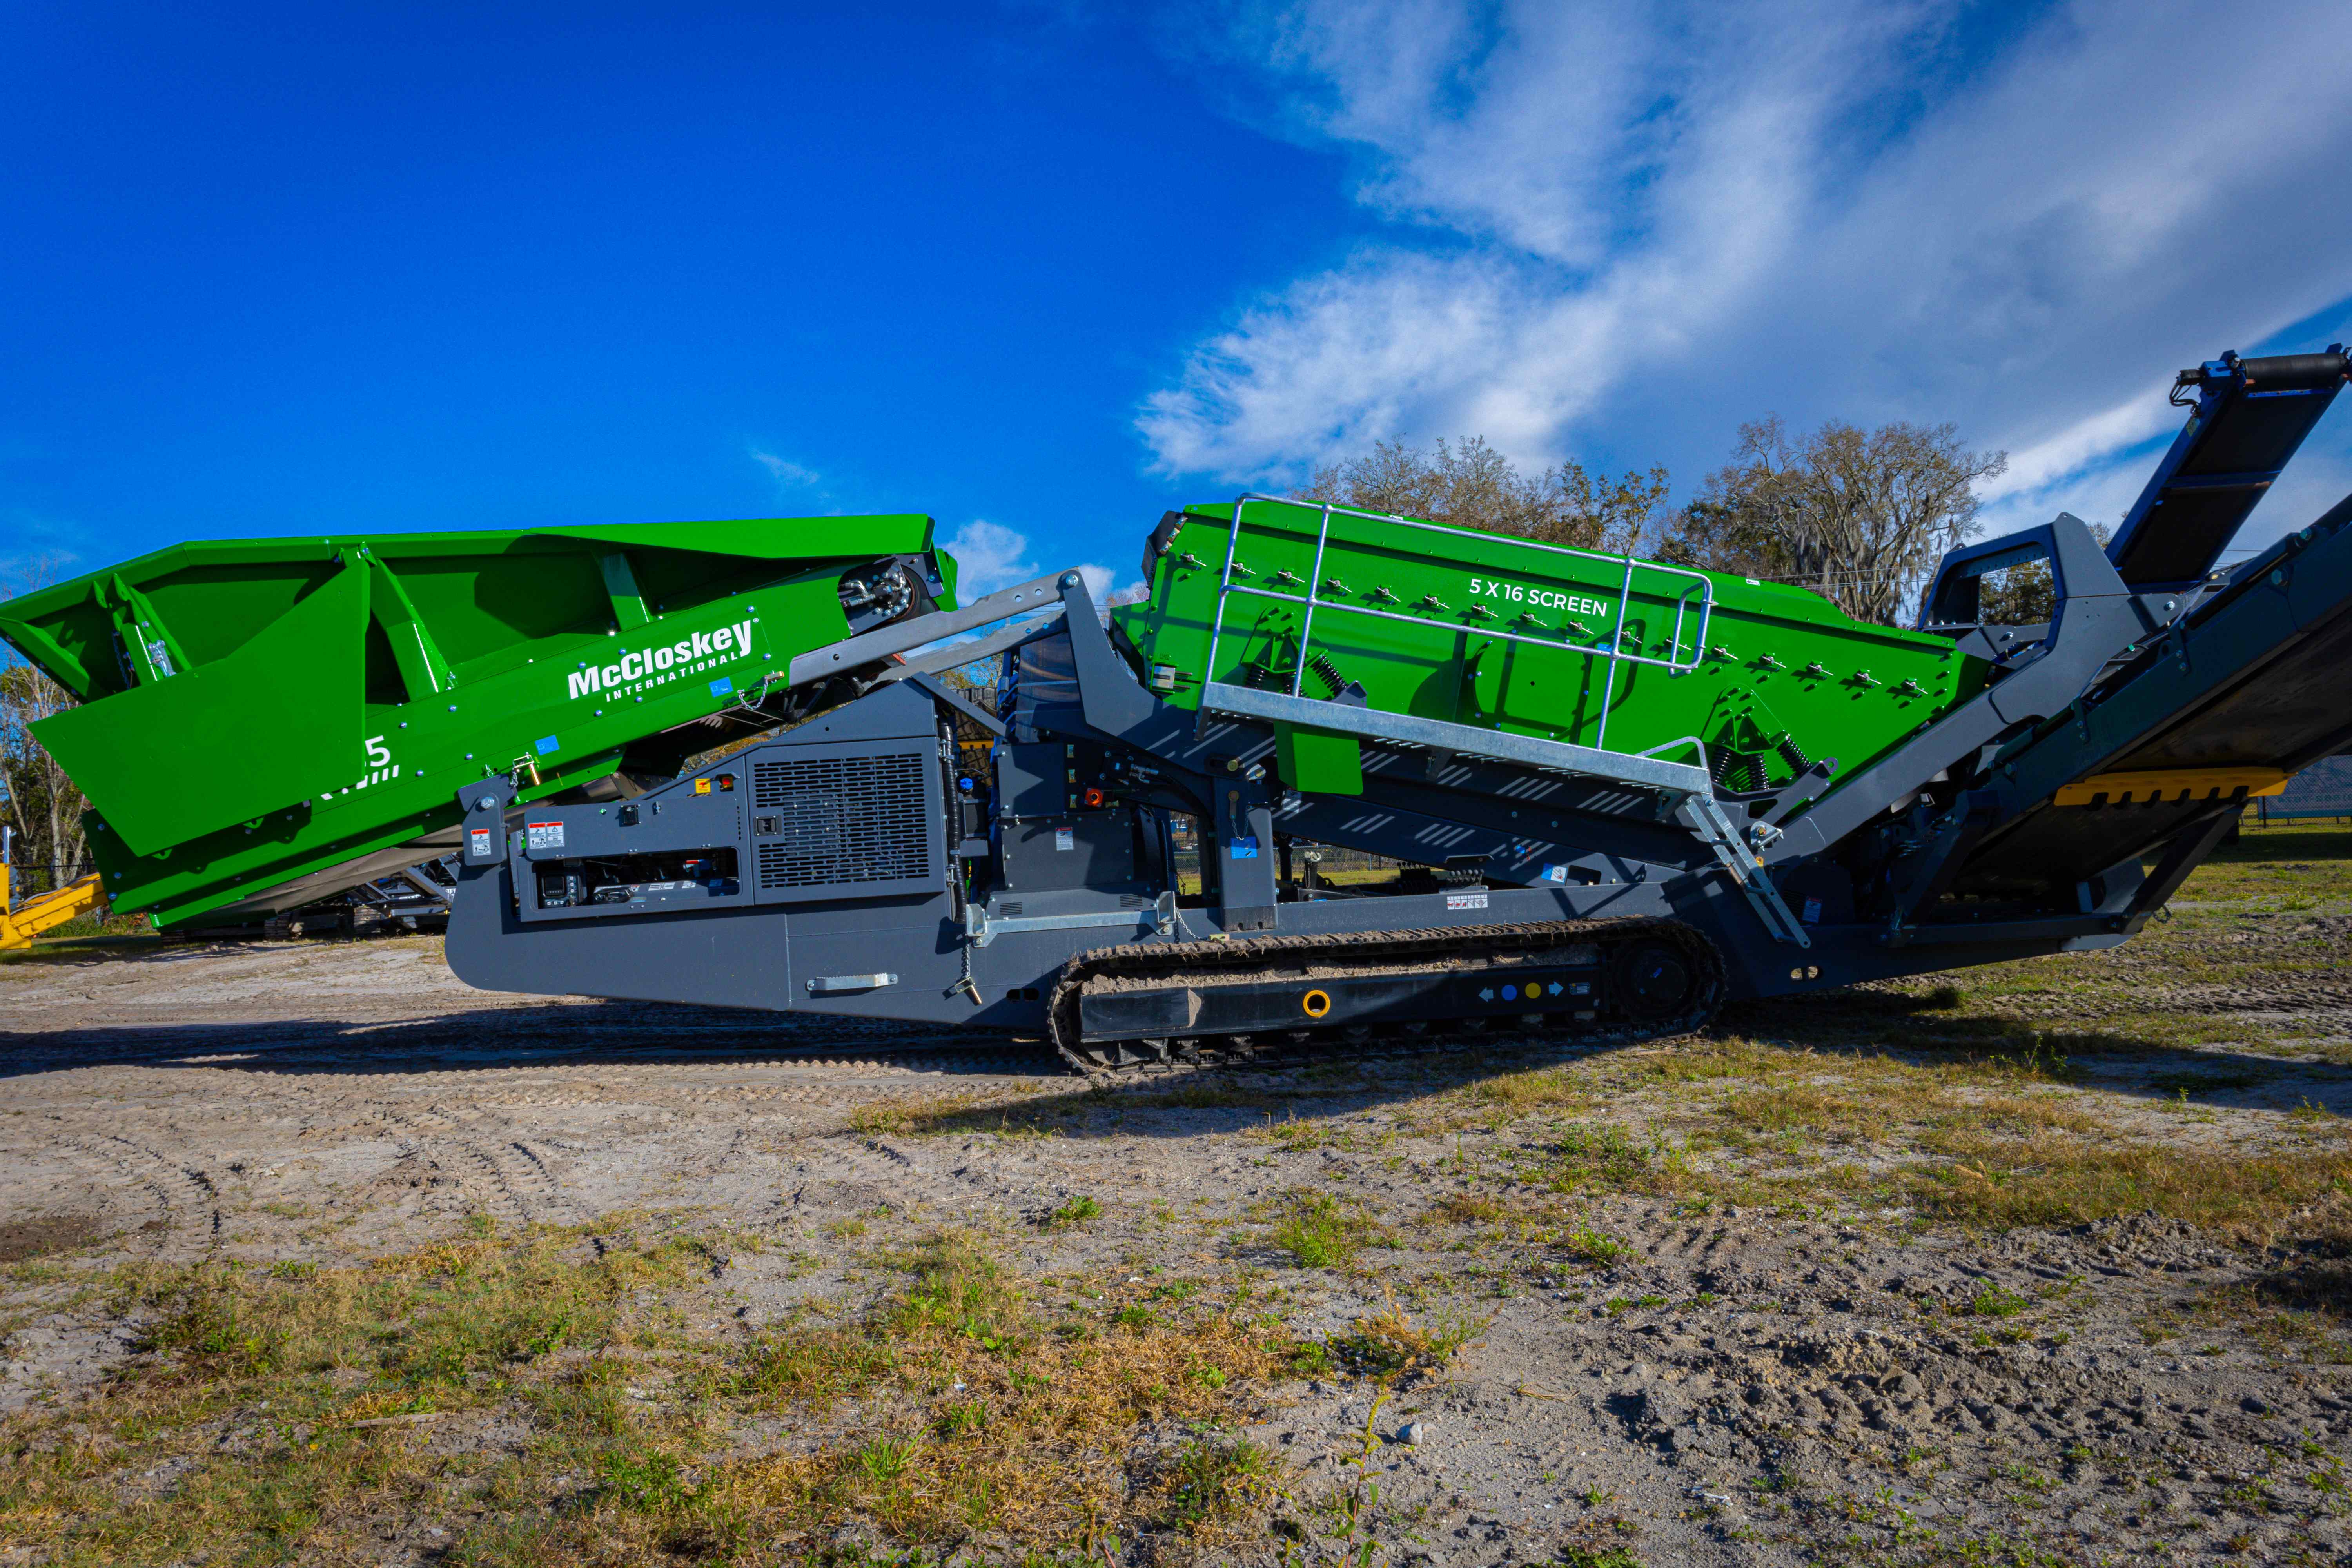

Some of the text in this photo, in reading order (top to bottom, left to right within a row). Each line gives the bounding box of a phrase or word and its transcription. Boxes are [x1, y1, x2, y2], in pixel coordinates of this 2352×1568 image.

[1469, 578, 1607, 617] 5 X 16 SCREEN
[568, 620, 751, 700] McCloskey
[606, 652, 738, 702] INTERNATIONAL
[365, 735, 390, 767] 5
